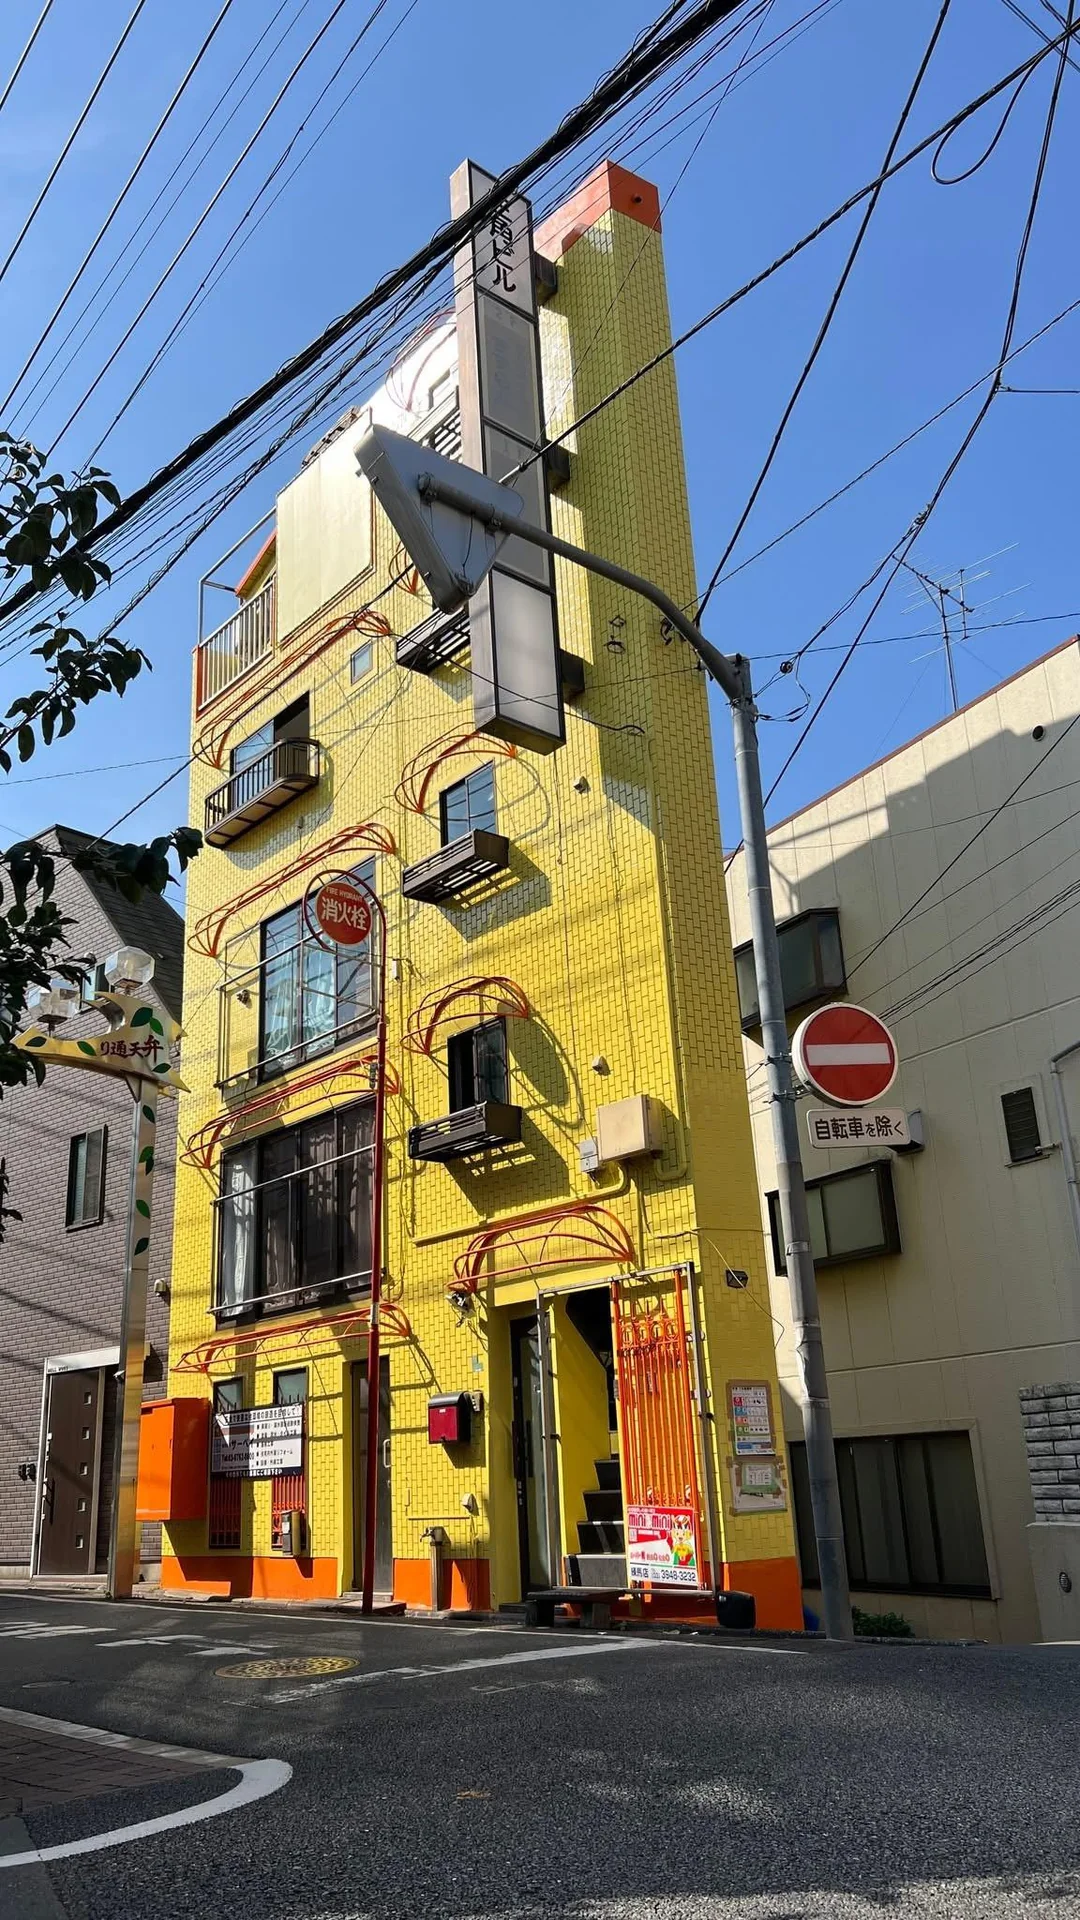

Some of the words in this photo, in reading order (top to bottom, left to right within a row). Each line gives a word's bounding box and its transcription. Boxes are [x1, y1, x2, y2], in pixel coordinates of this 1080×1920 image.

[325, 886, 338, 896] FIRE
[339, 889, 363, 902] HYDRANT
[321, 896, 368, 931] 消火栓
[814, 1115, 904, 1140] 自転車を除く
[628, 1513, 646, 1527] mini
[651, 1514, 670, 1529] mini
